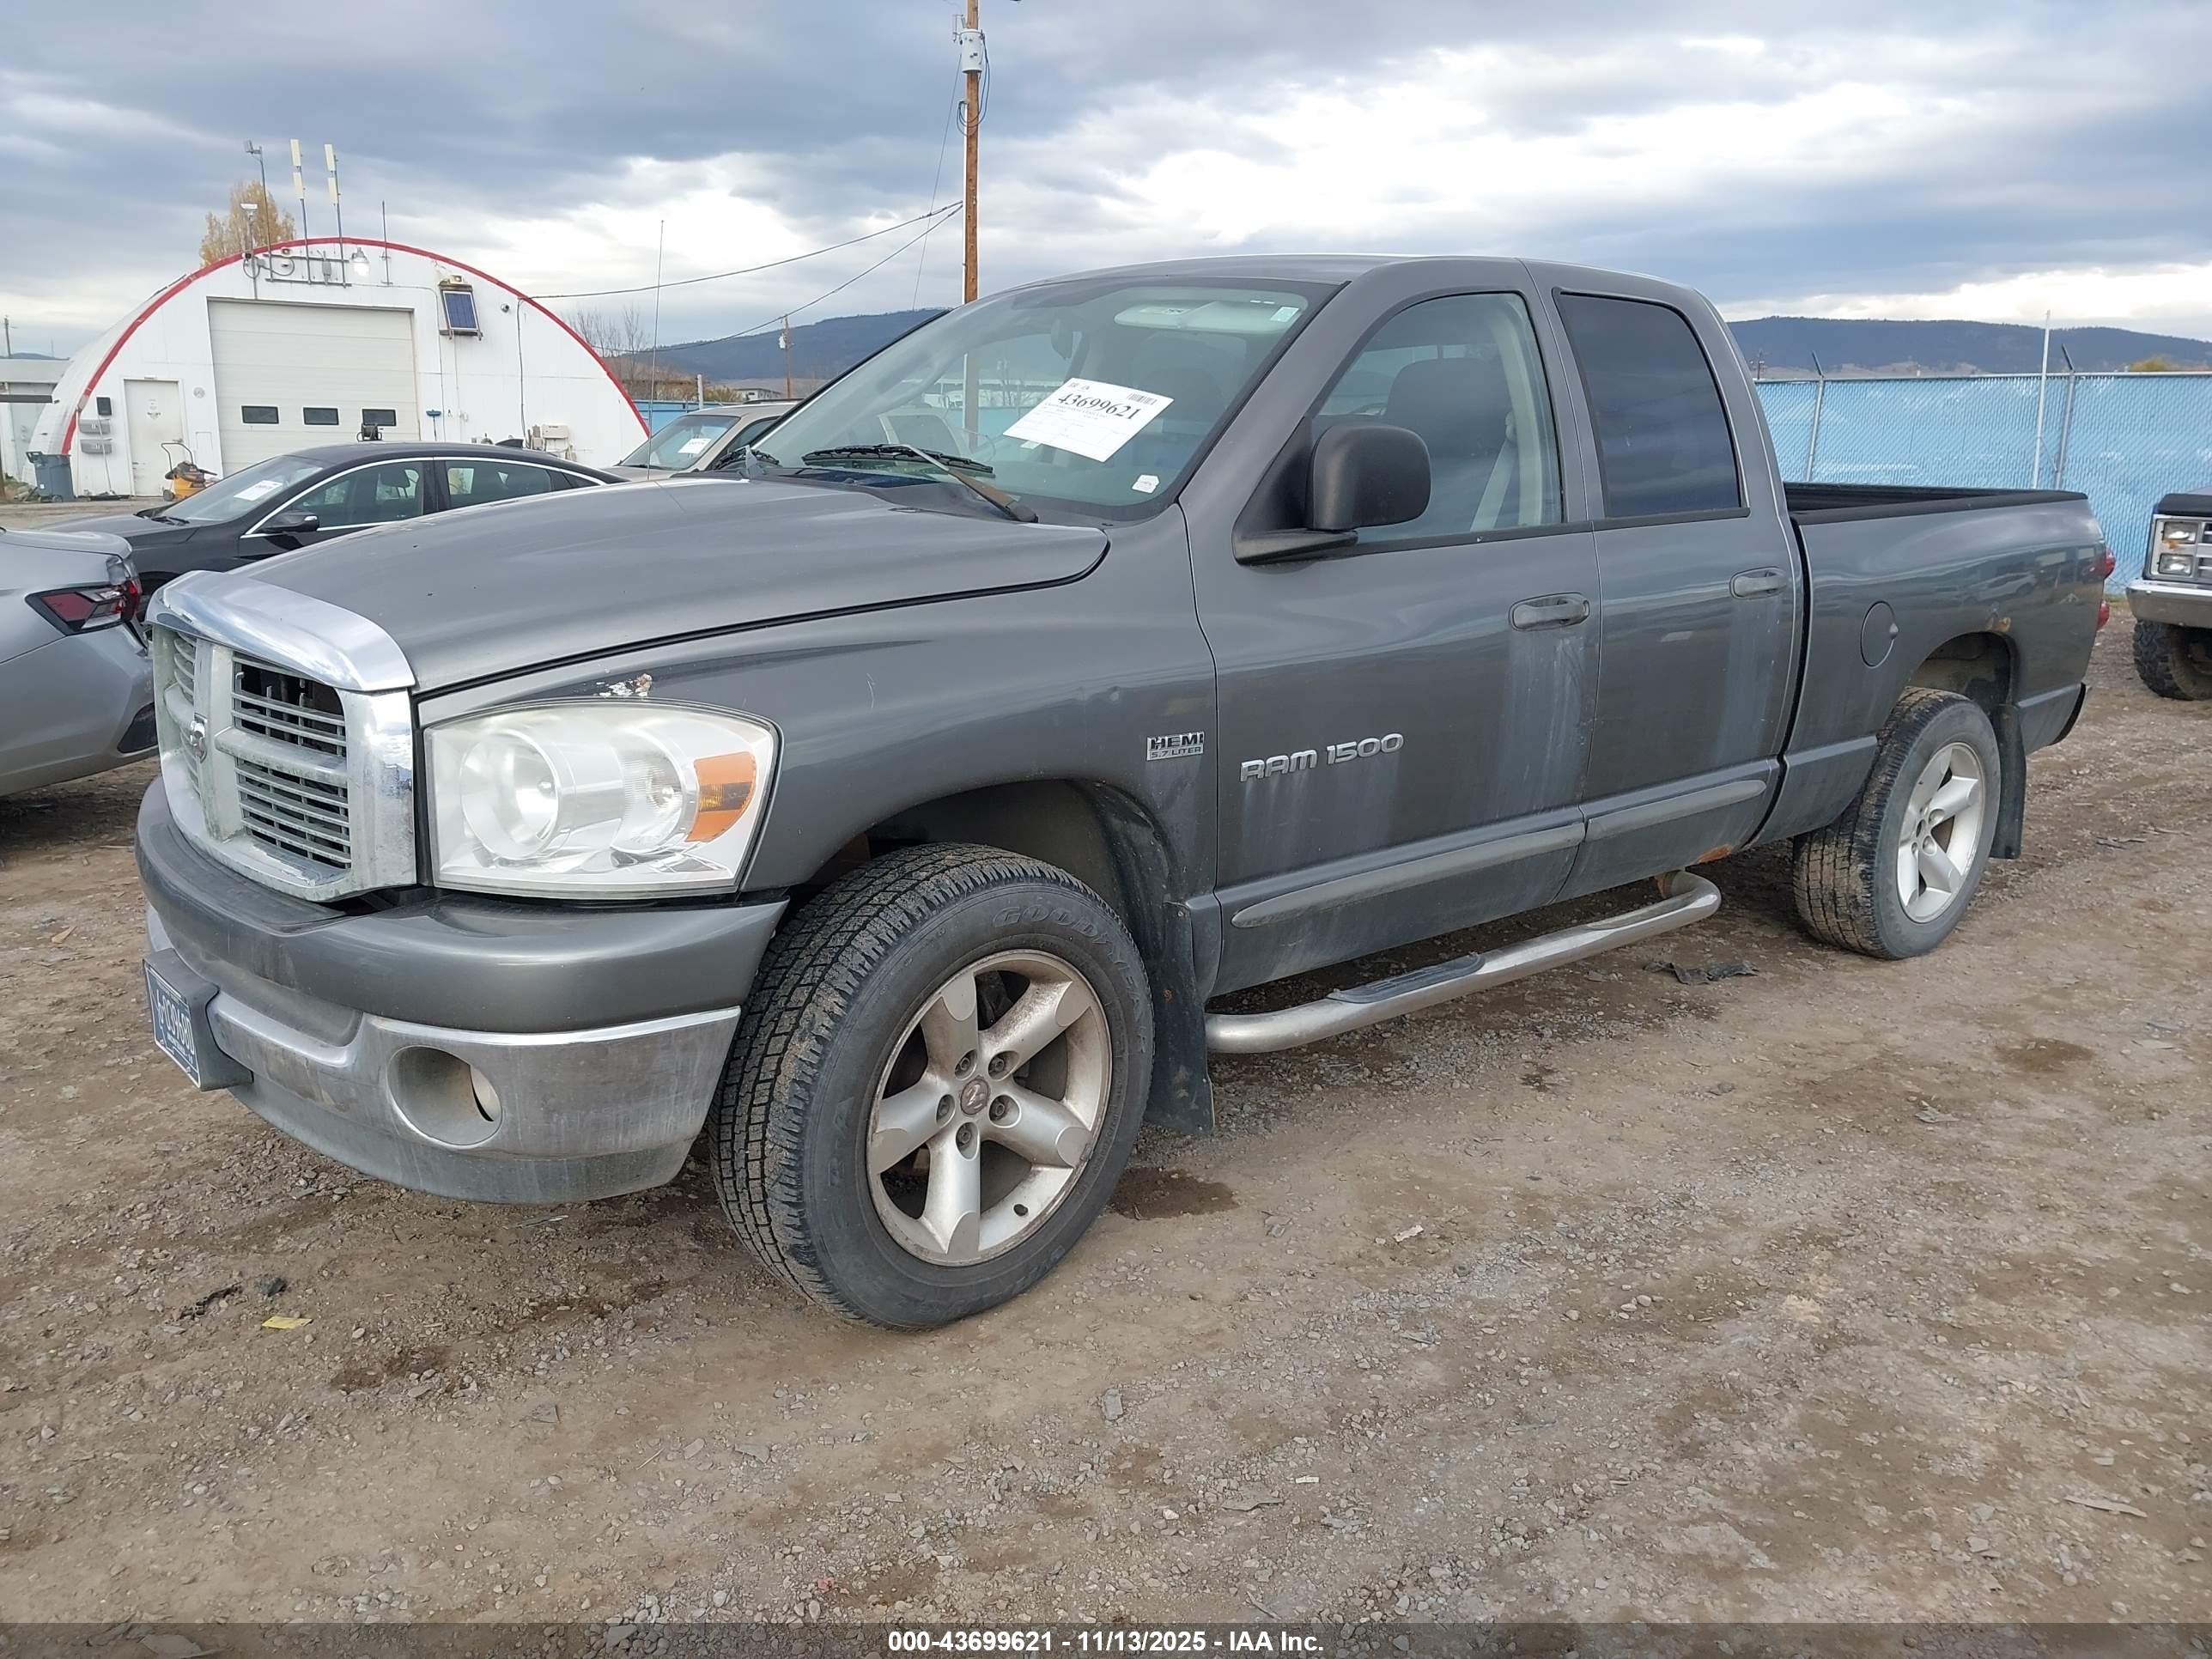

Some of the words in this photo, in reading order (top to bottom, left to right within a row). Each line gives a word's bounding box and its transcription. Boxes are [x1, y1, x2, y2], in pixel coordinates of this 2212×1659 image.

[1058, 393, 1141, 419] 43699621
[1151, 733, 1204, 750] HEMI
[1171, 746, 1201, 756] LITER
[1239, 749, 1318, 782] RAM
[1327, 732, 1404, 765] 1500
